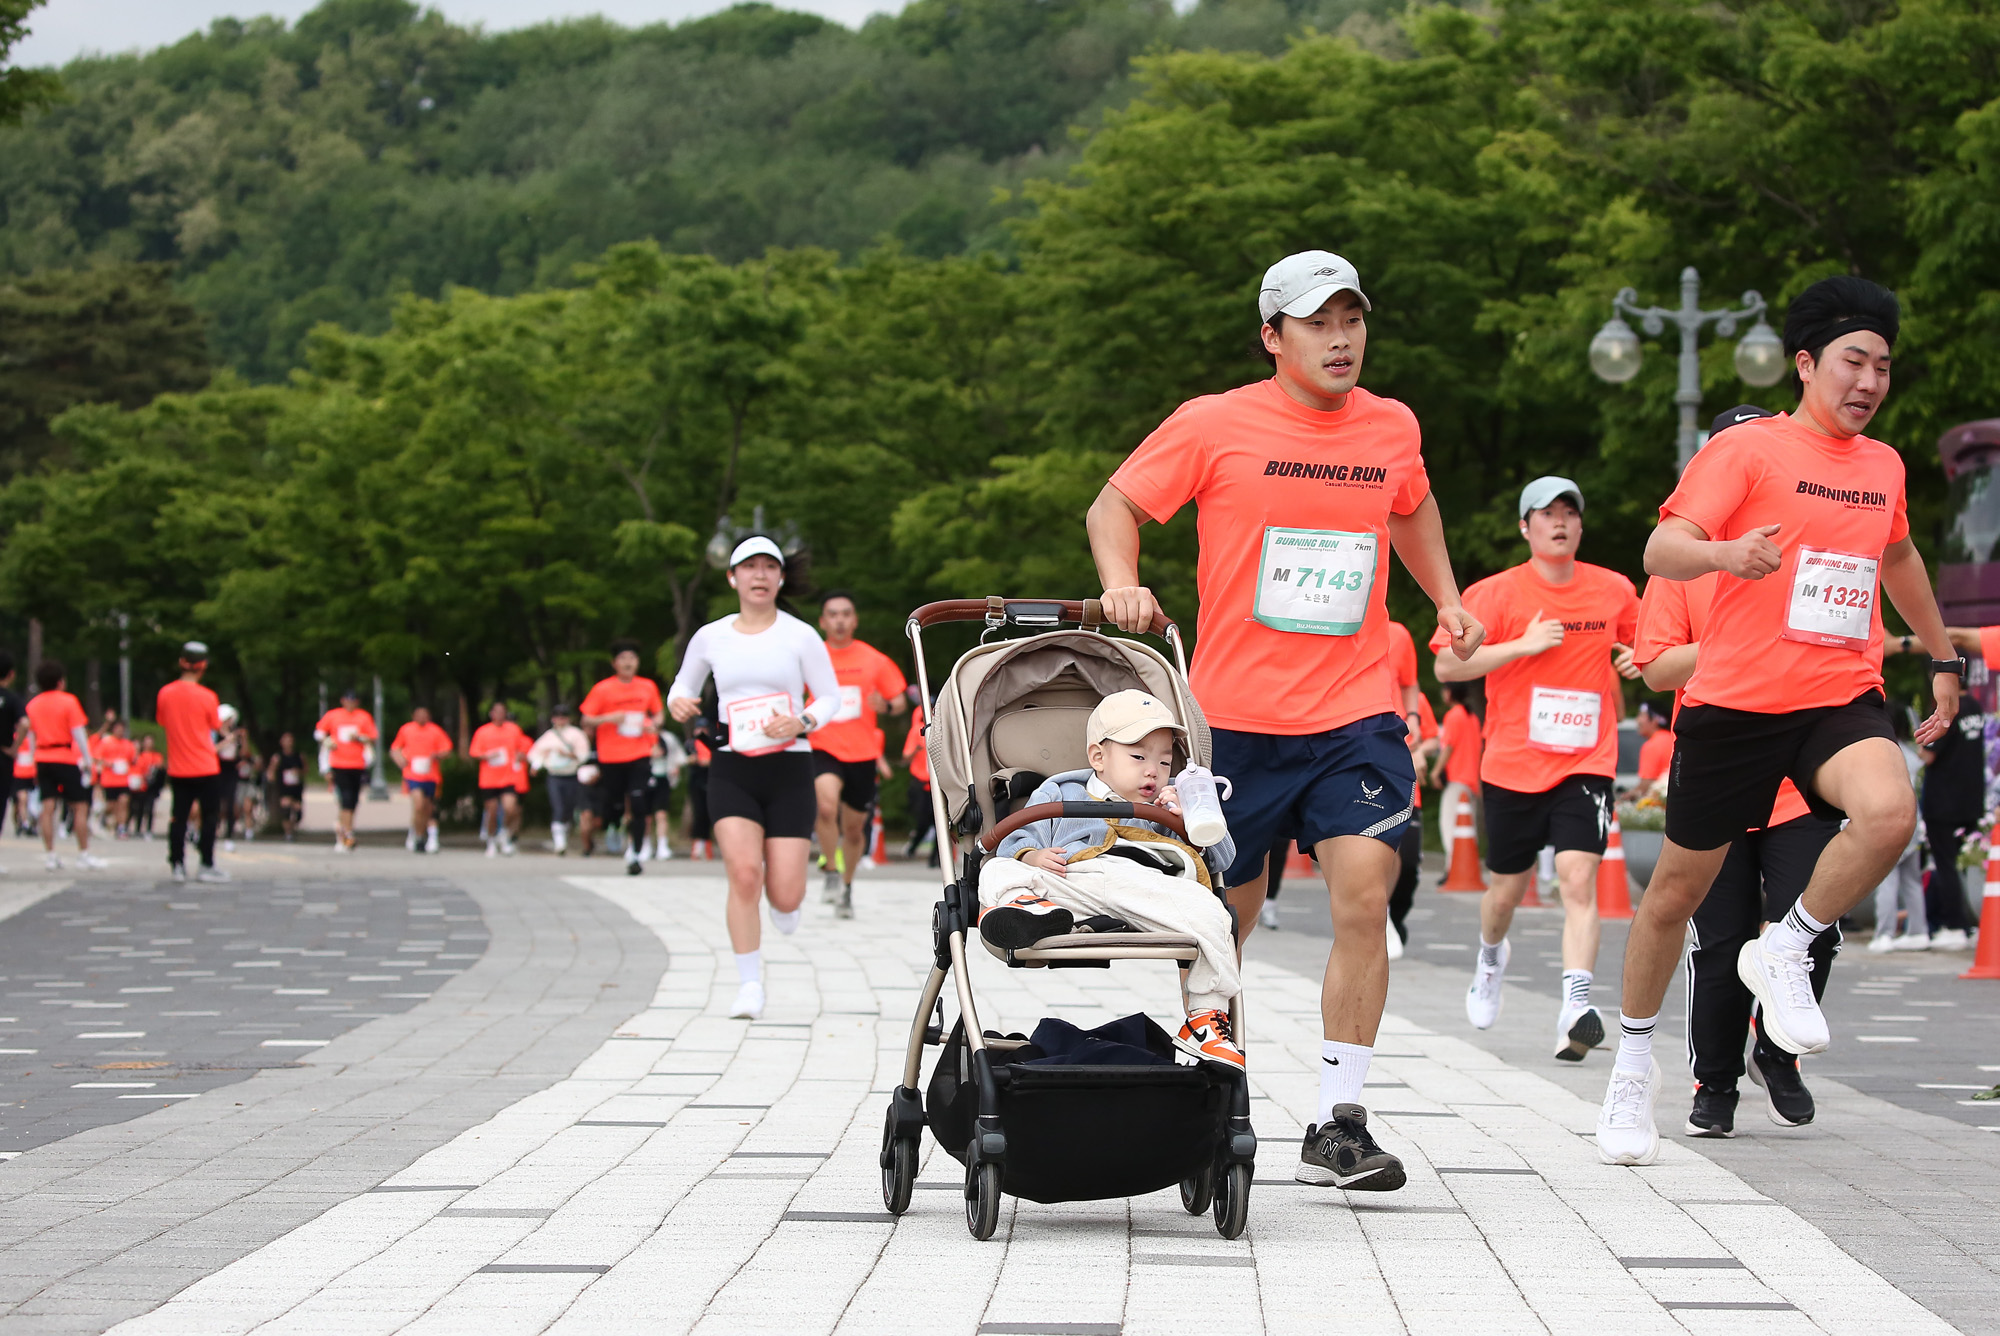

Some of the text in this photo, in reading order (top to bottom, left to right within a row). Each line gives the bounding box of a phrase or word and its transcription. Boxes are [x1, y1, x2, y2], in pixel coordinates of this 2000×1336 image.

[1263, 460, 1387, 483] BURNING RUN
[1343, 482, 1365, 490] Running
[1796, 480, 1886, 506] BURNING RUN
[1275, 536, 1340, 549] BURNING RUN
[1354, 543, 1372, 551] 7km
[1806, 557, 1842, 569] BURNING
[1842, 561, 1859, 571] RUN
[1272, 567, 1364, 591] M 7143
[1802, 583, 1870, 609] M 1322
[1583, 620, 1607, 631] RUN
[1553, 711, 1593, 727] 1805
[1320, 1138, 1339, 1159] N
